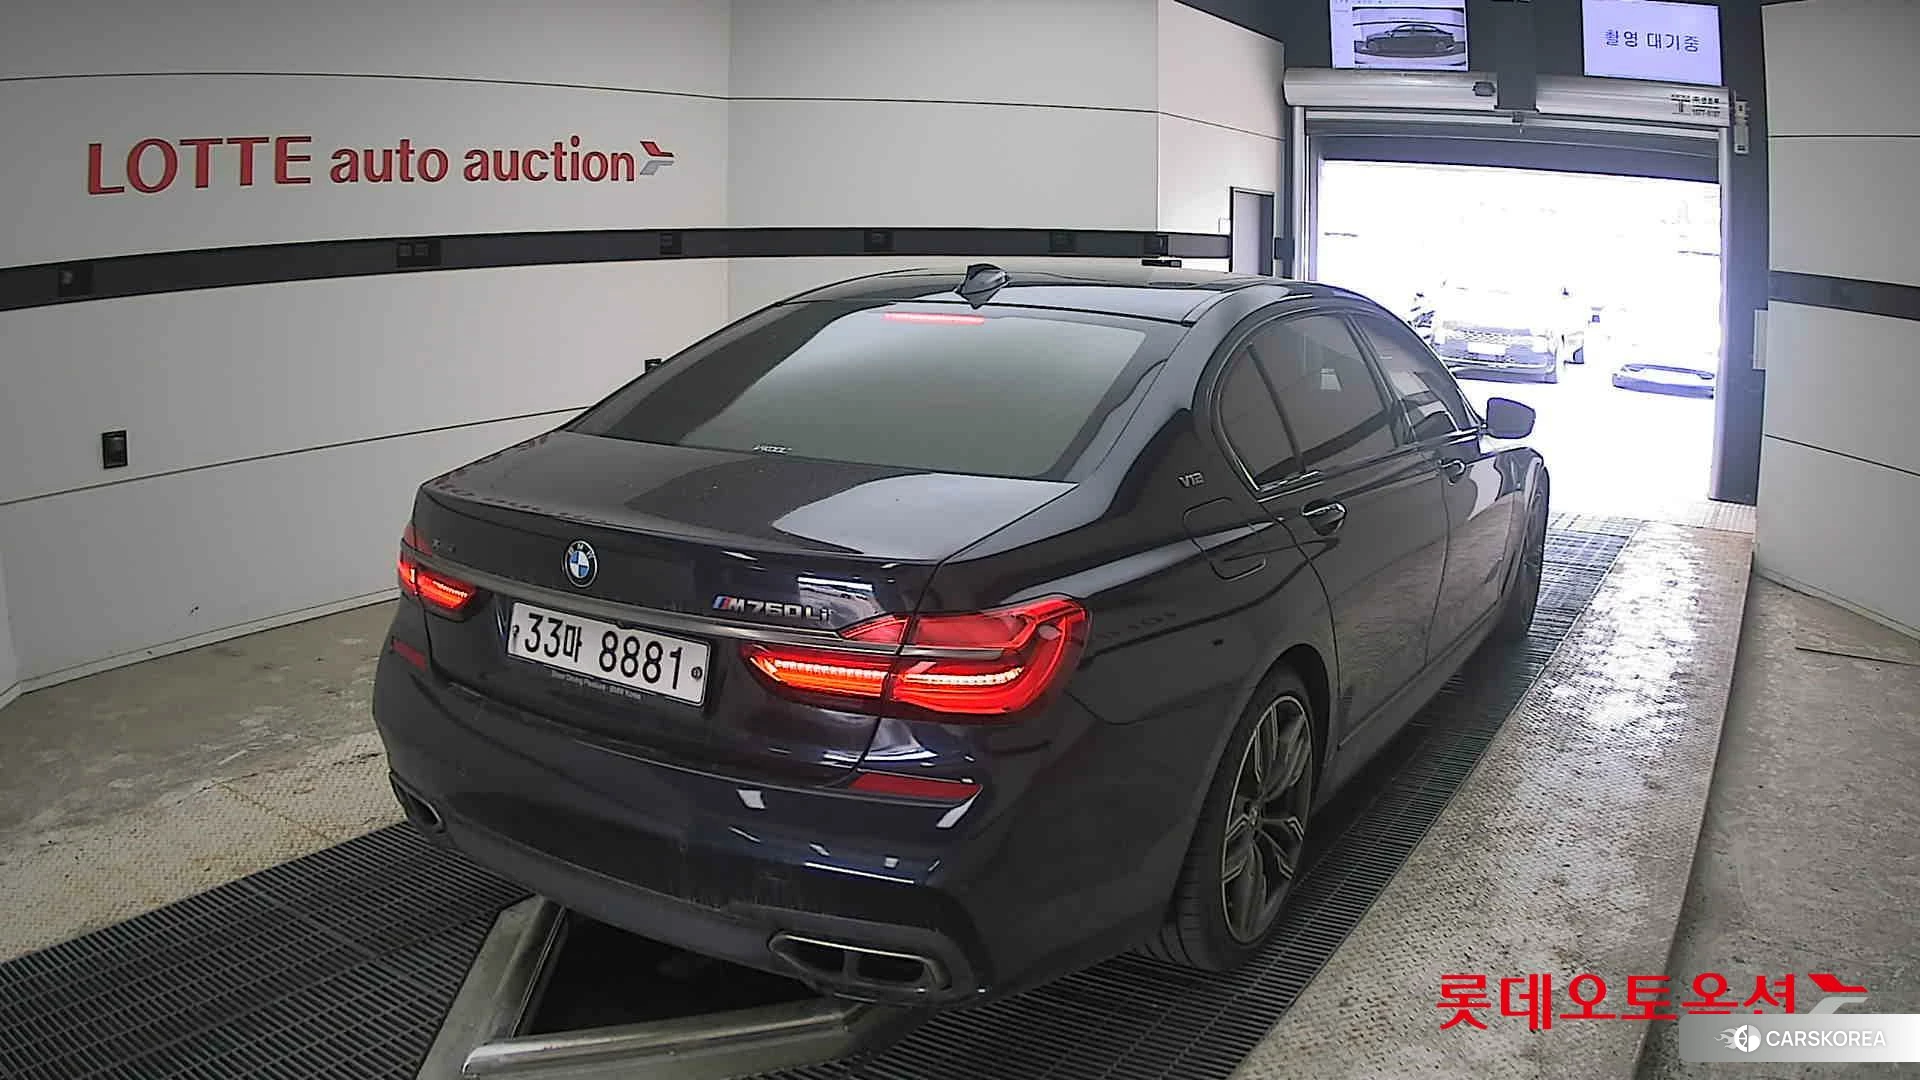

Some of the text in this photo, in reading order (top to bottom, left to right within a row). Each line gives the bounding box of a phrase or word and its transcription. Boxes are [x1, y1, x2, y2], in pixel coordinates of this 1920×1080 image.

[1646, 32, 1700, 52] 대기중
[87, 135, 635, 195] LOTTE auto auction
[1178, 472, 1205, 488] V12
[524, 607, 582, 663] 33마
[599, 630, 683, 690] 8881
